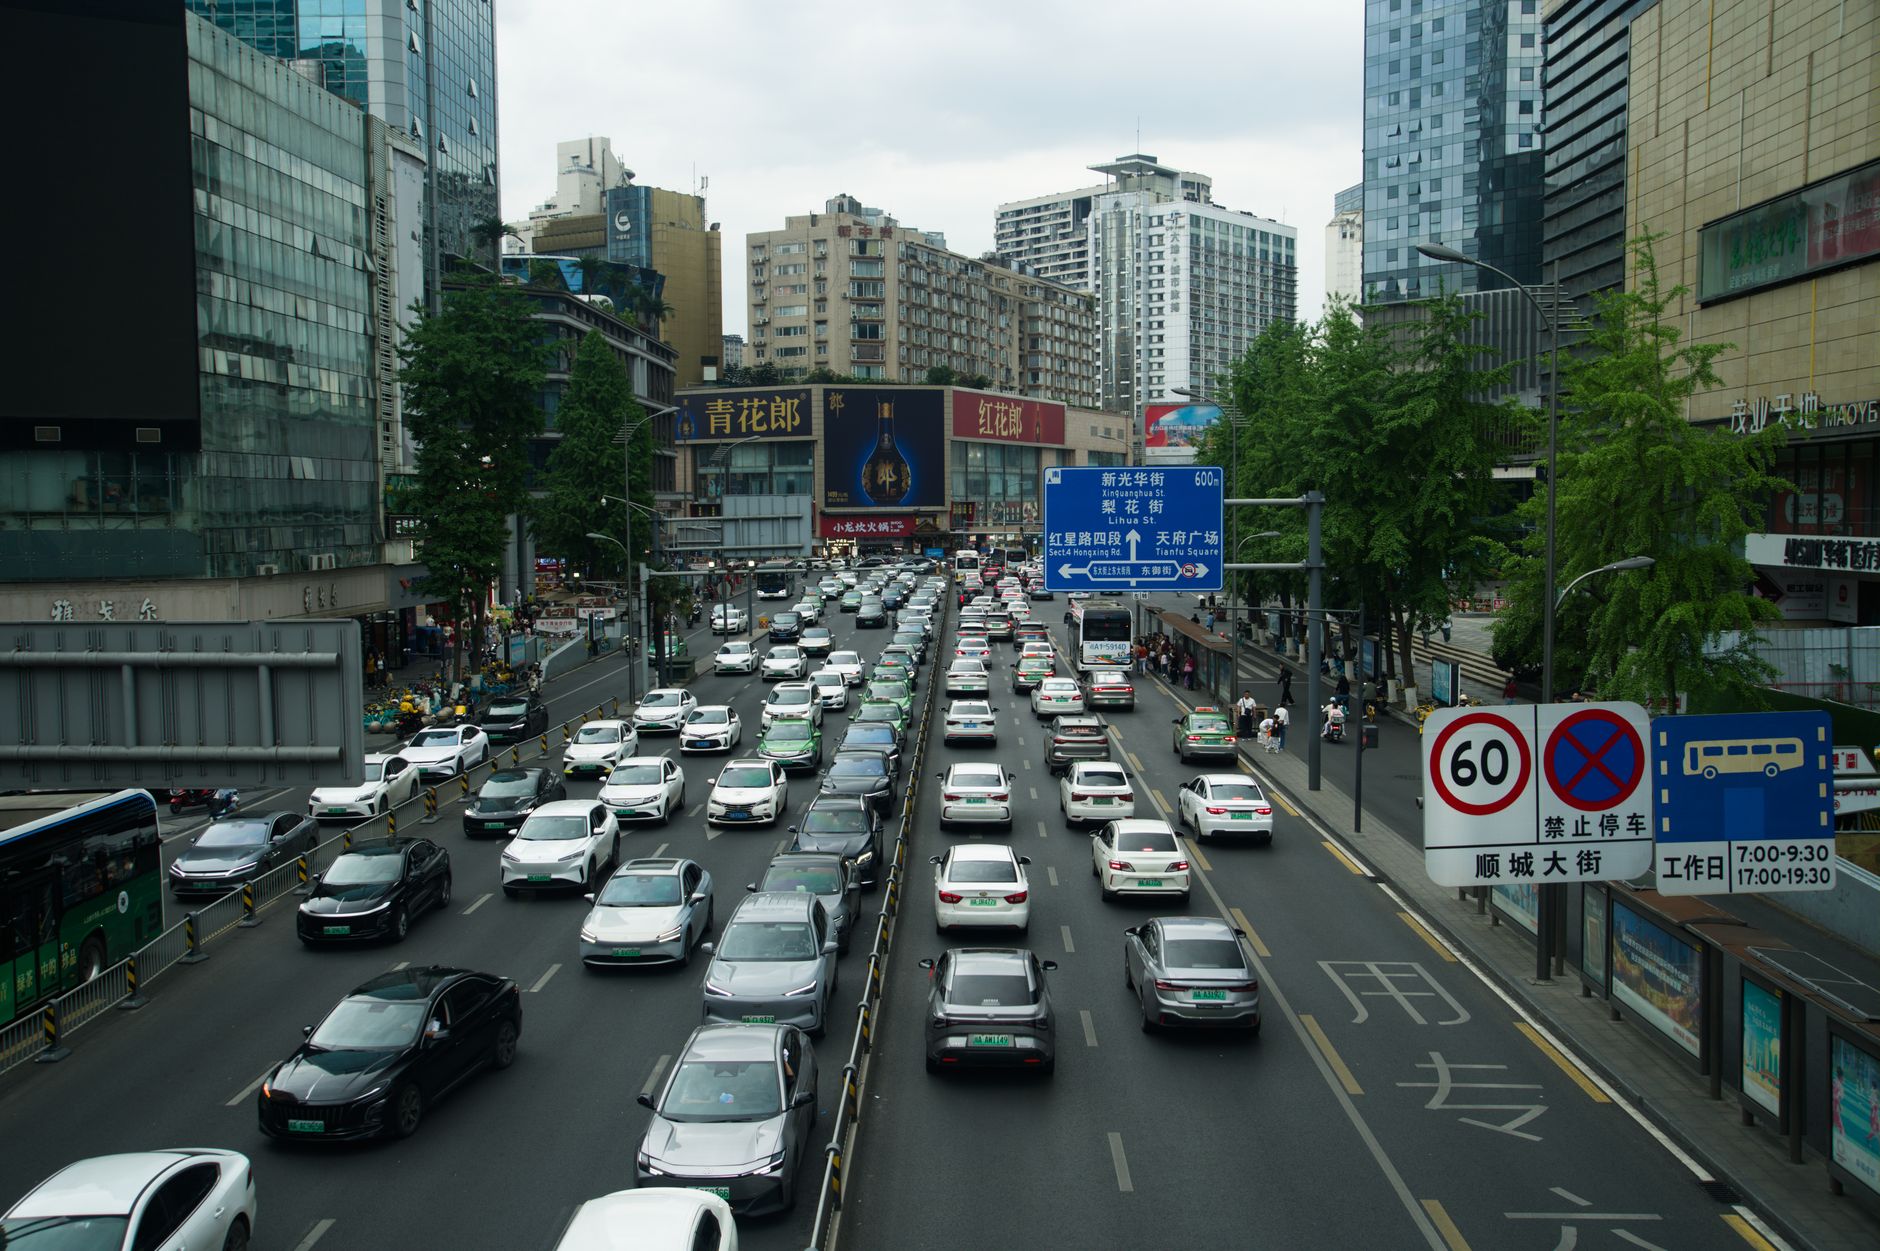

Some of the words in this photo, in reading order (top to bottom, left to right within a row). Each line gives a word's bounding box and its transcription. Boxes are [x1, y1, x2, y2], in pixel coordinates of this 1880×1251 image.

[705, 395, 801, 435] 青花郎
[978, 399, 1023, 439] 红花郎
[1731, 390, 1819, 434] 茂业天地
[1101, 472, 1165, 487] 新光华街
[1156, 489, 1165, 497] St.
[1101, 499, 1163, 514] 梨花街
[832, 520, 890, 534] 小龙坎火锅
[1108, 516, 1139, 525] Lihua
[1142, 516, 1157, 525] St.
[1049, 531, 1122, 547] 红星路四段
[1156, 530, 1219, 546] 天府广场
[1073, 548, 1109, 558] Hongxing
[1111, 548, 1122, 556] Rd.
[1155, 548, 1185, 556] Tianfu
[1187, 548, 1219, 557] Square
[1141, 565, 1172, 576] 东御街
[51, 598, 159, 621] 雅戈尔
[1450, 739, 1509, 787] 60
[1544, 812, 1647, 840] 禁止停车
[1736, 845, 1830, 863] 7:00-9:30
[1475, 850, 1602, 880] 顺城大街
[1662, 855, 1724, 881] 工作日
[1737, 868, 1831, 886] 17:00-19:30
